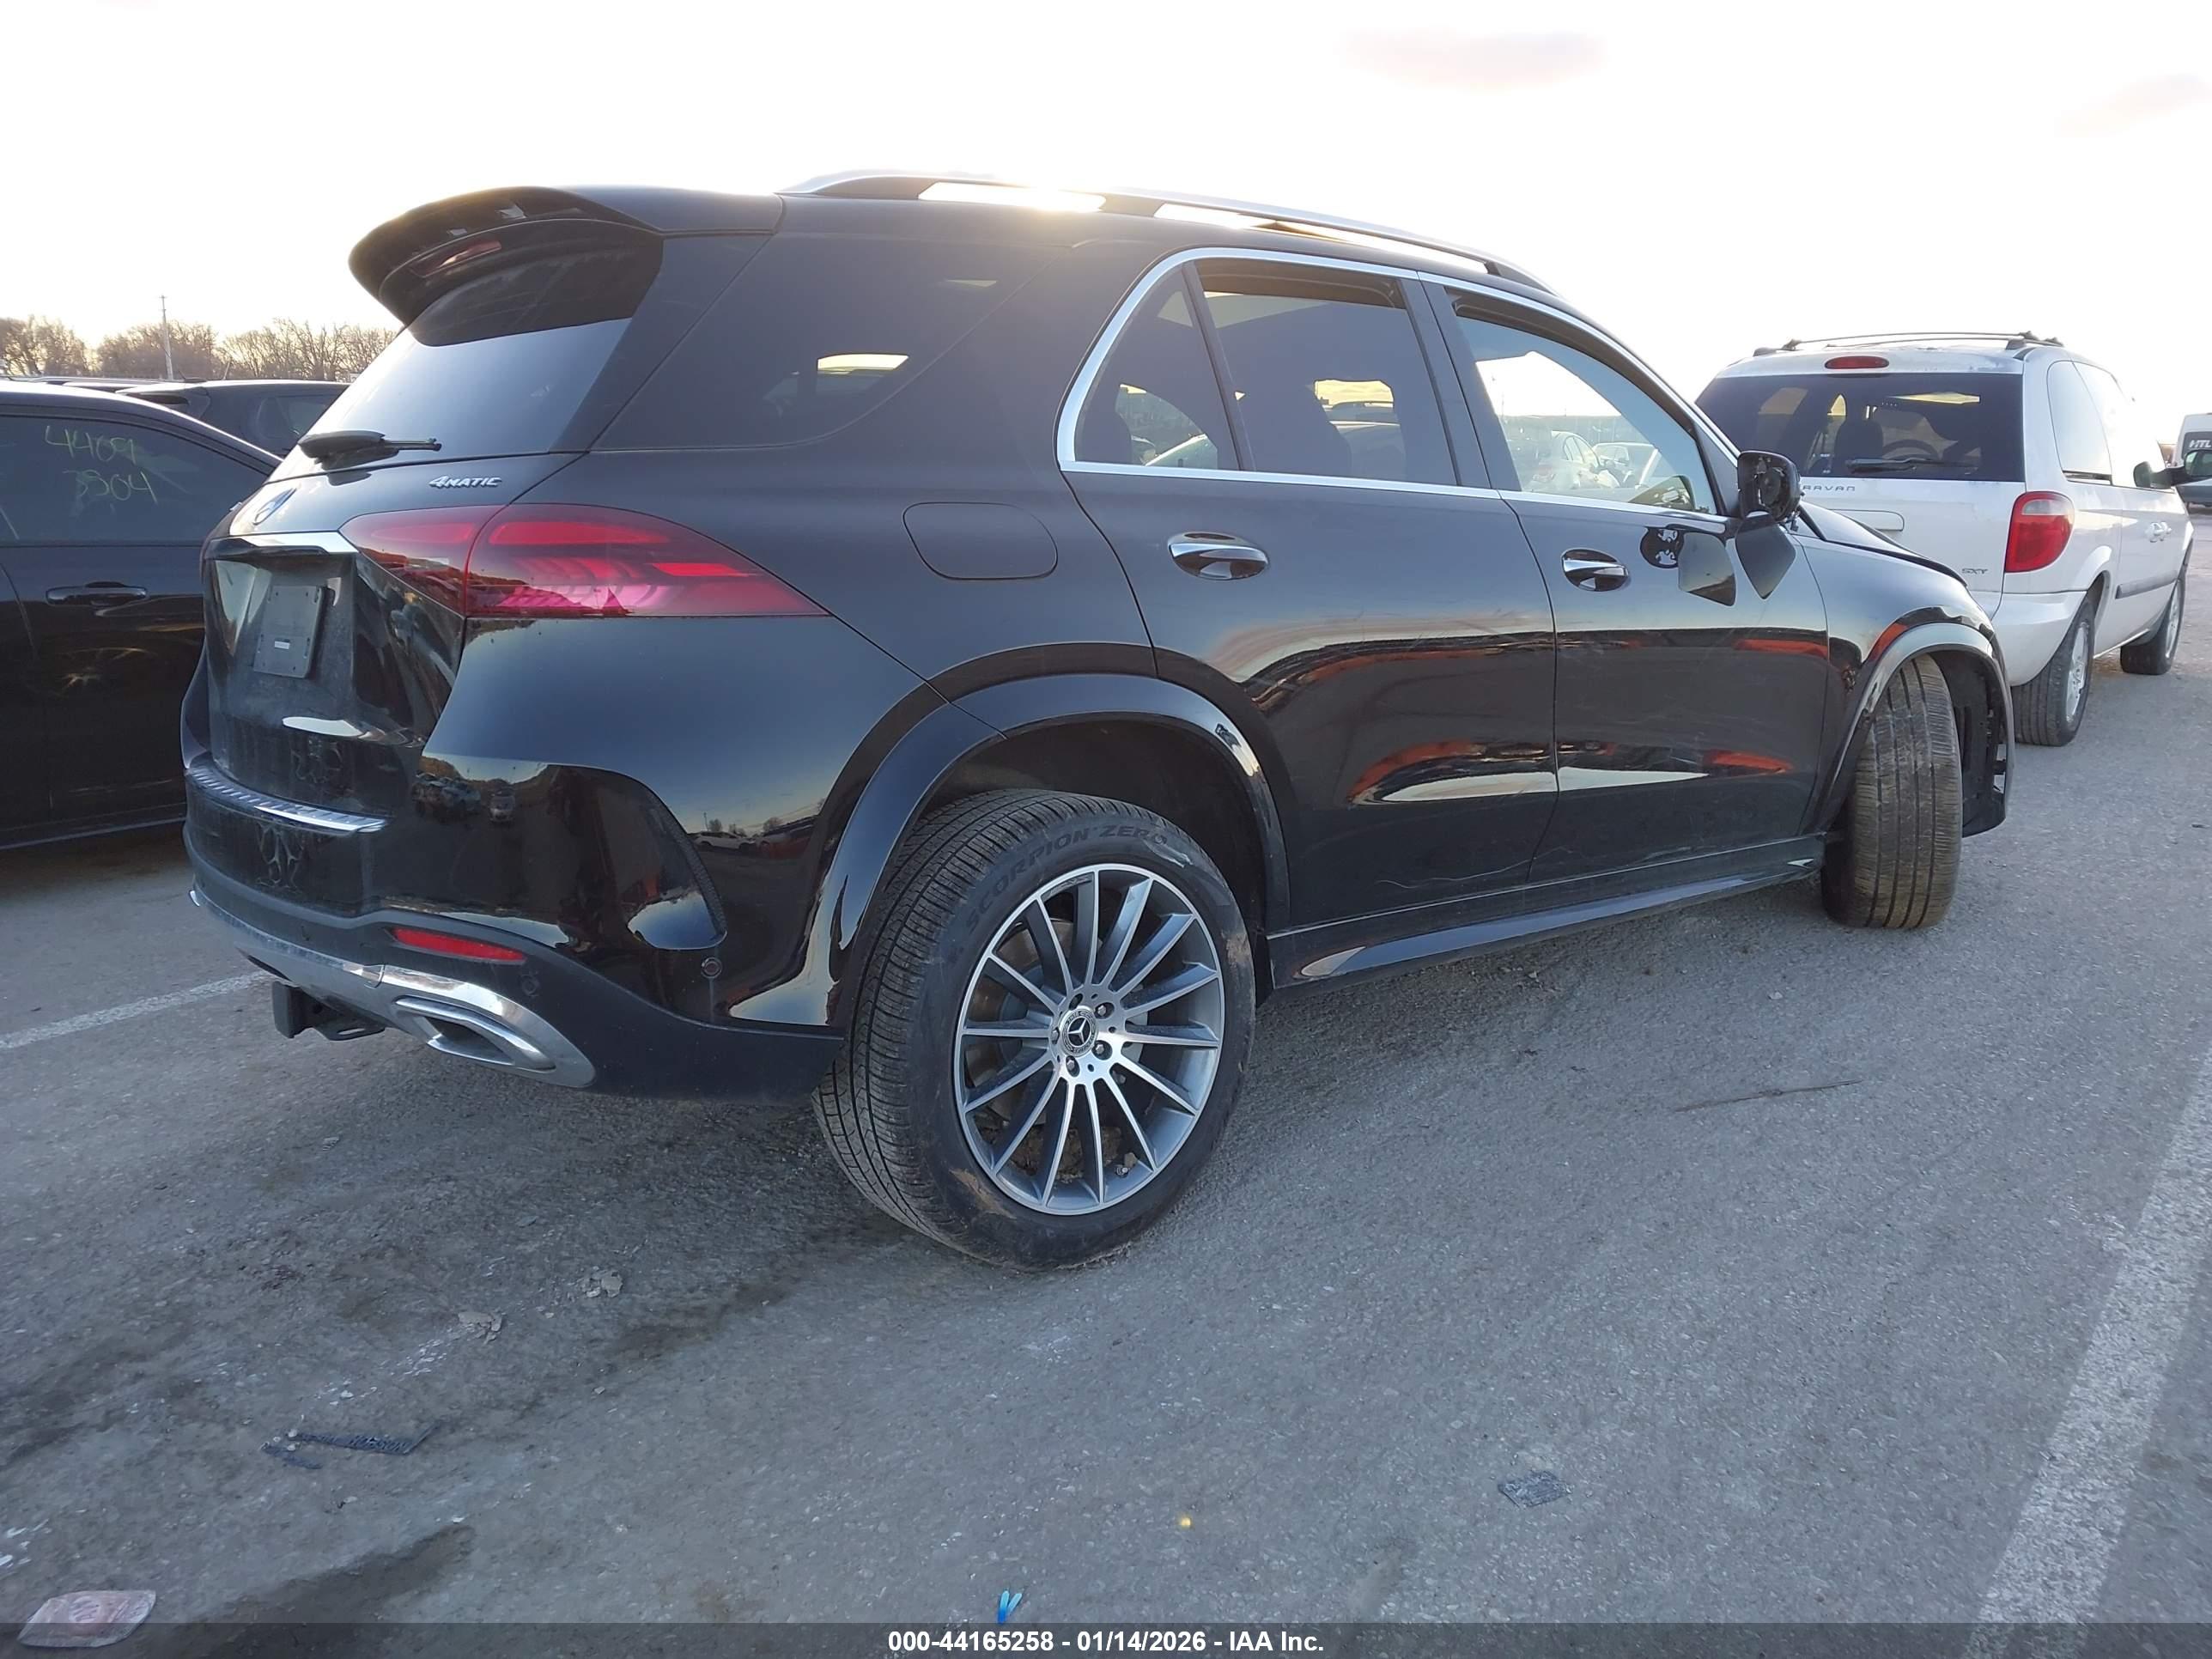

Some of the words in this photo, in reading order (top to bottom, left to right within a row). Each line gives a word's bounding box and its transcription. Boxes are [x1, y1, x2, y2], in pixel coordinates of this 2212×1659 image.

[428, 475, 501, 489] 4MATIC
[967, 827, 1090, 935] SCORPION
[1098, 824, 1168, 846] ZERO
